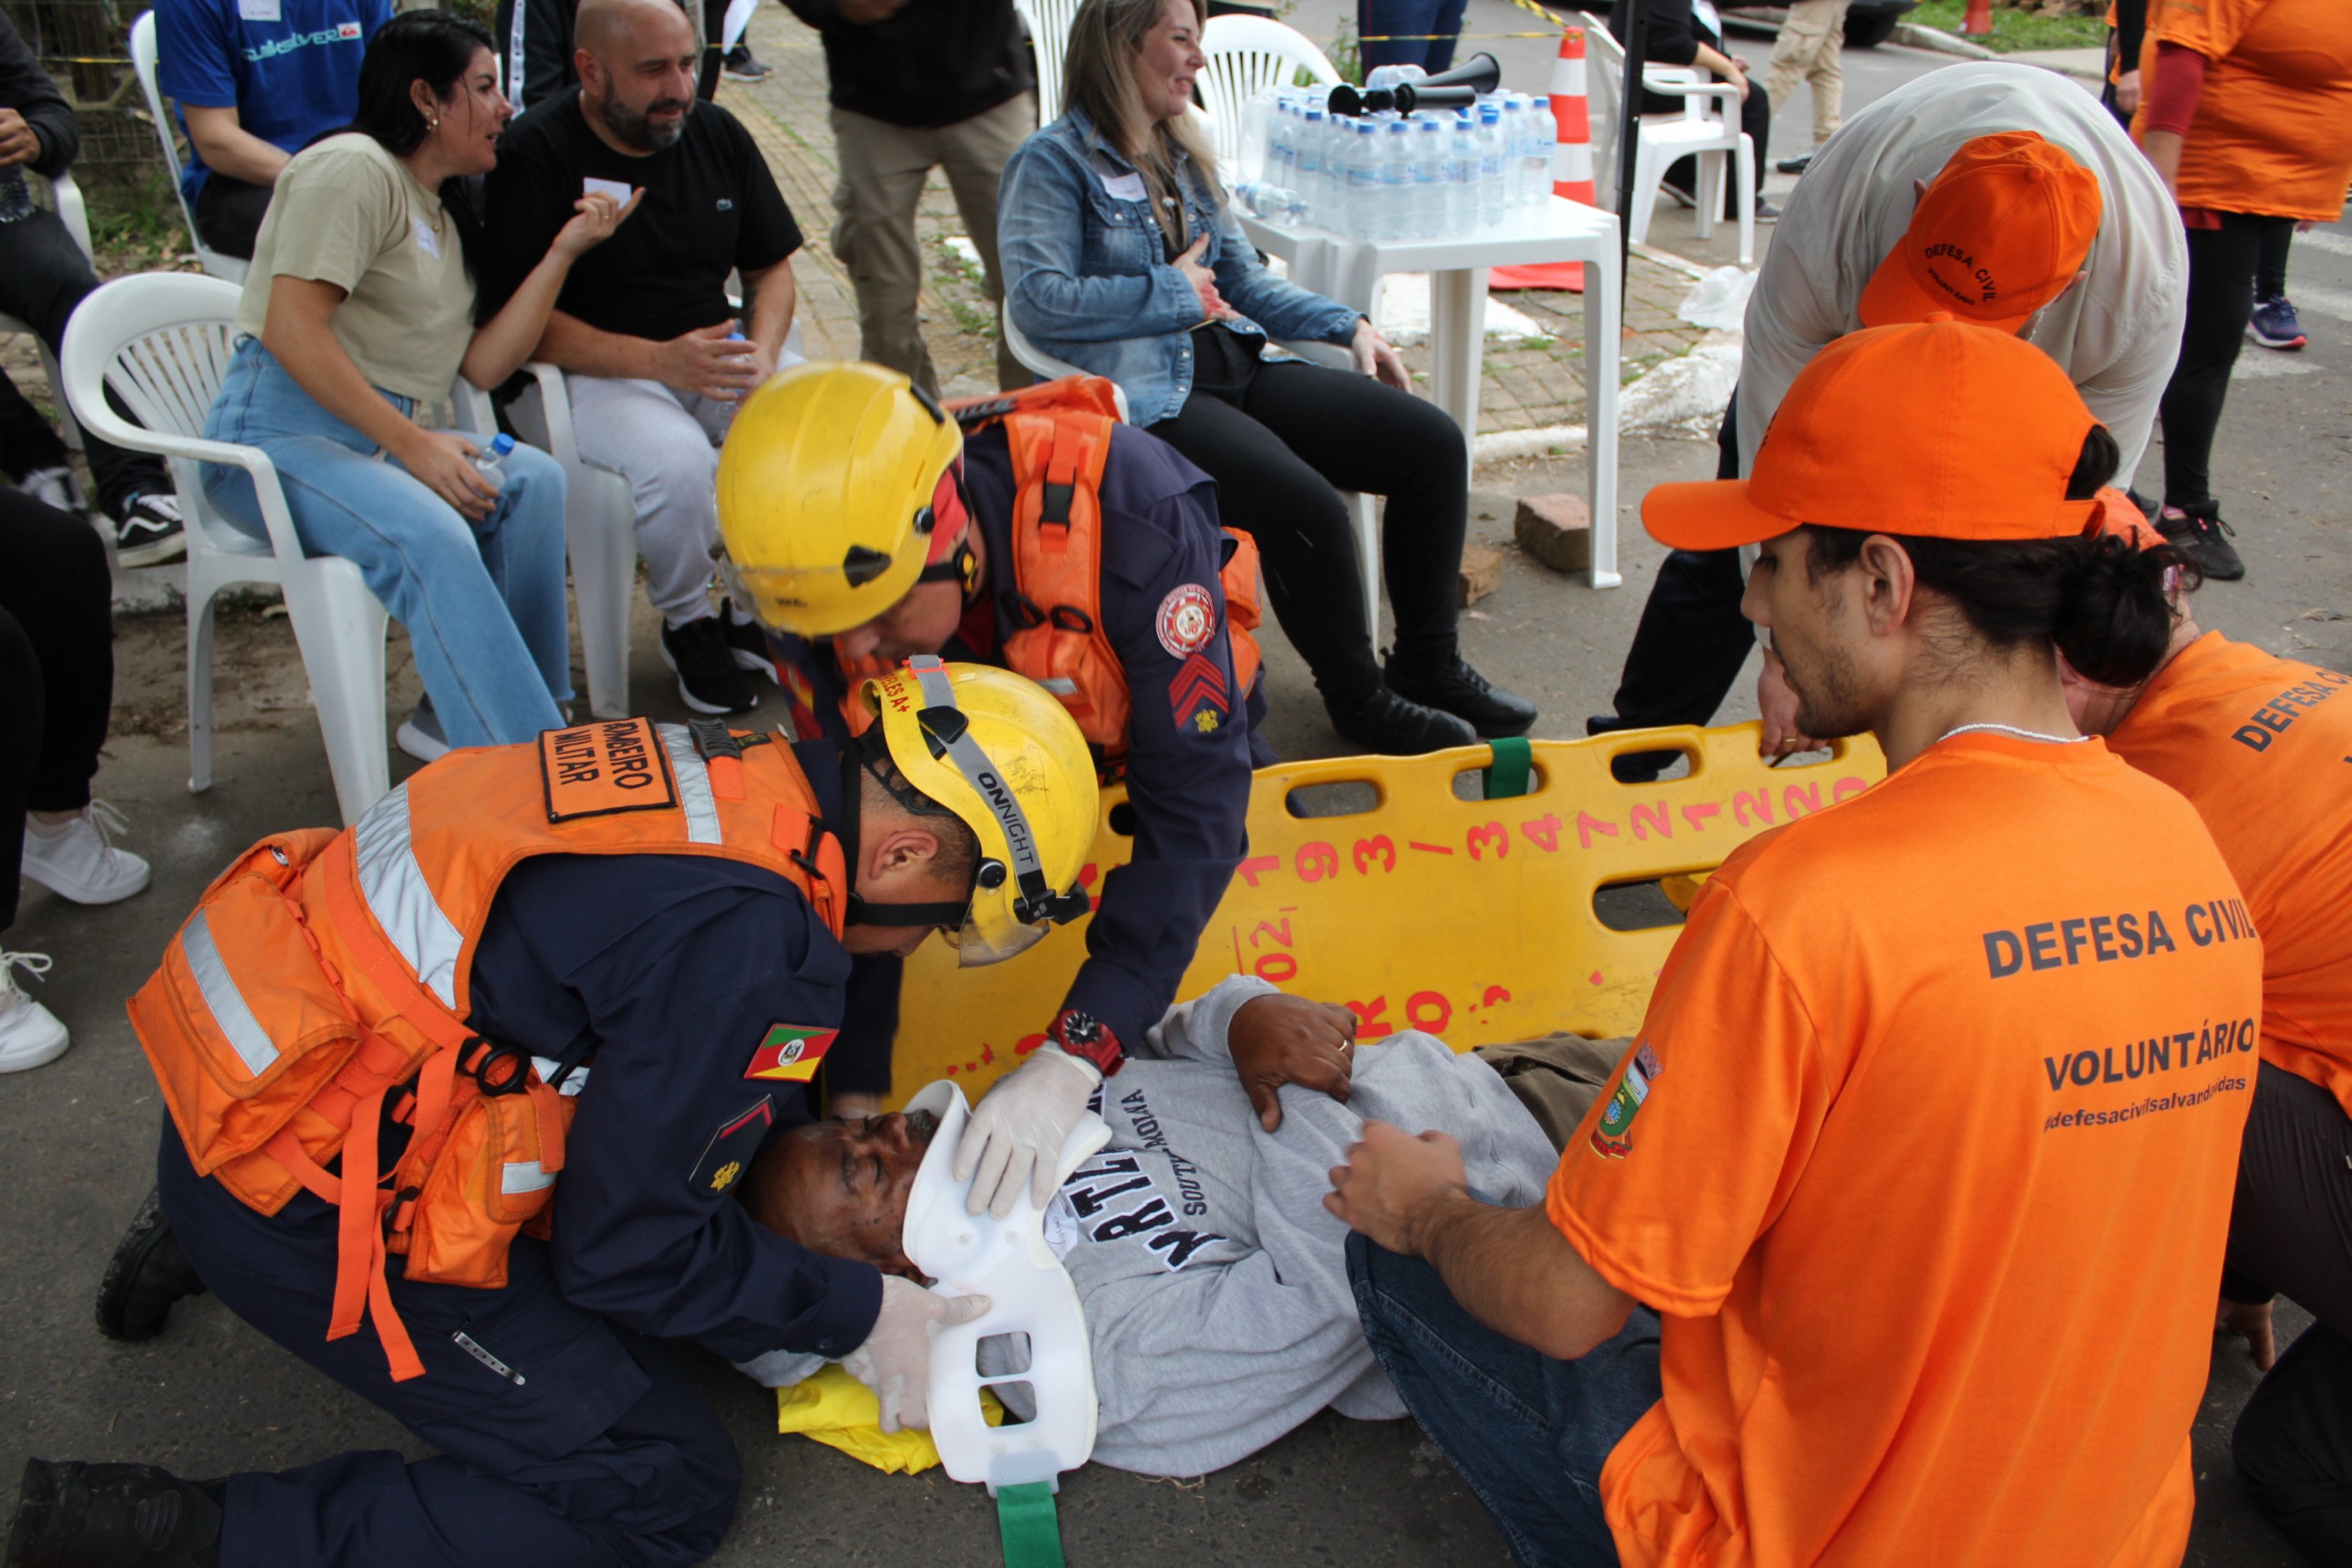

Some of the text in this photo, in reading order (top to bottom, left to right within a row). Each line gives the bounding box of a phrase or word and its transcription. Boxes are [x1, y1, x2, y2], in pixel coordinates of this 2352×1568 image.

[1925, 243, 1996, 303] DEFESA CIVIL
[2231, 681, 2339, 753] DEFESA
[553, 729, 600, 786] MILITAR
[602, 721, 653, 790] BOMBEIRO
[977, 771, 1035, 865] ONNIGHT
[1982, 898, 2256, 980] DEFESA CIVIL
[2043, 1018, 2255, 1092] VOLUNTÁRIO
